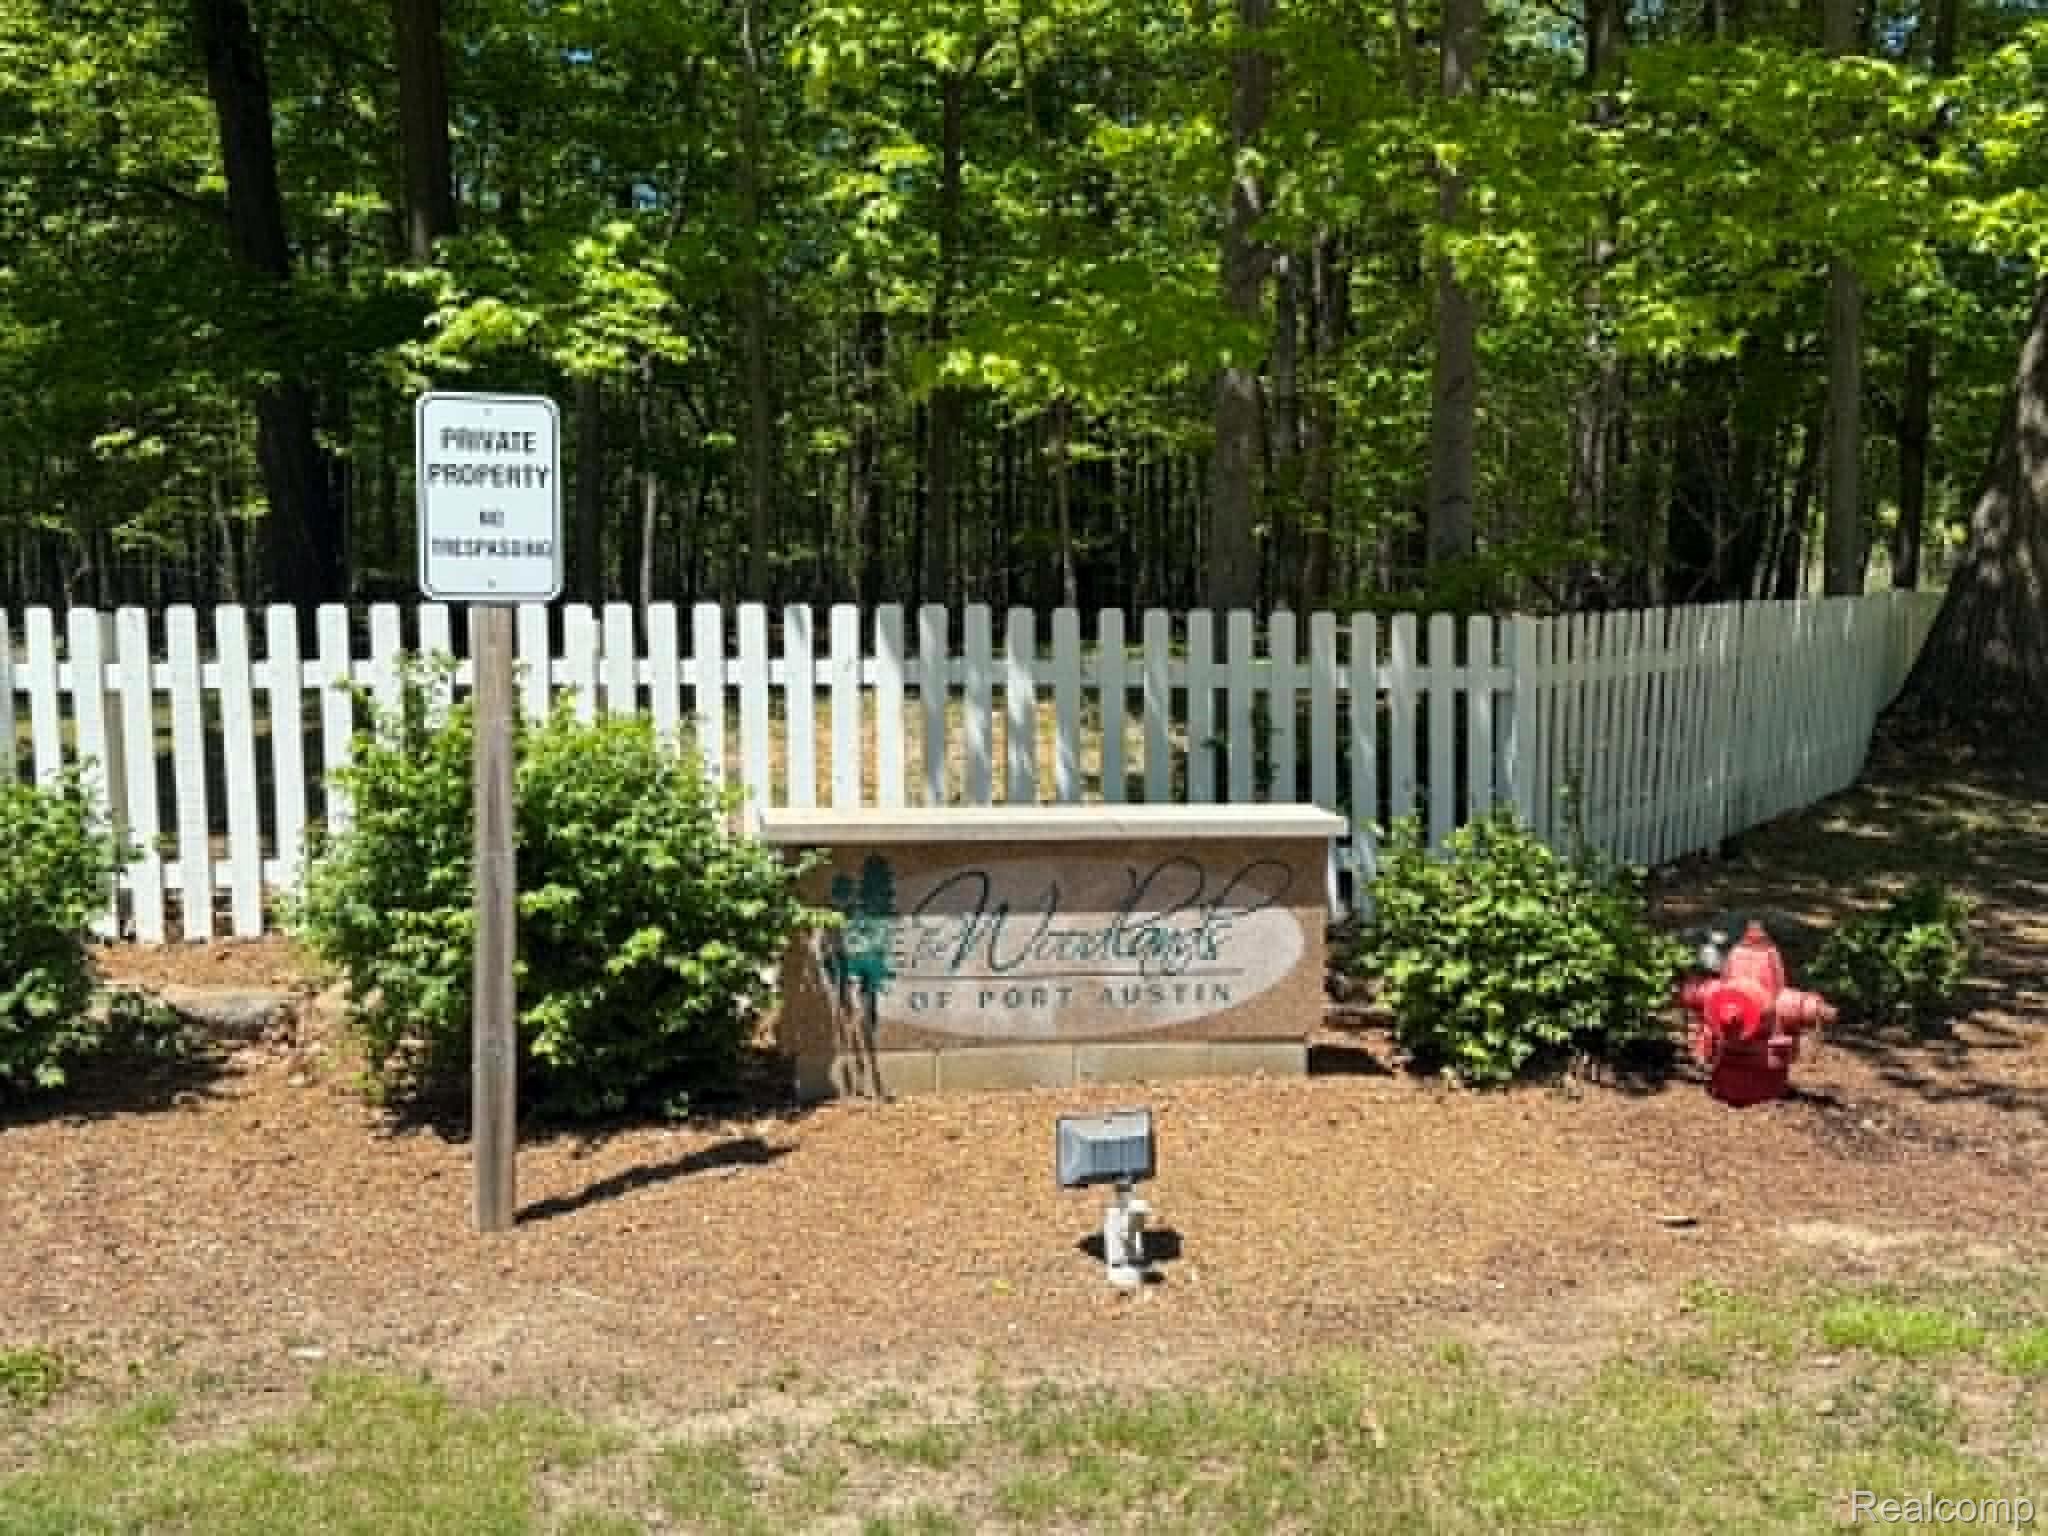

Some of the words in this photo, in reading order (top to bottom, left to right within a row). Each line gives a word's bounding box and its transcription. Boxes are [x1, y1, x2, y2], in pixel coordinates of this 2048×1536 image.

[439, 426, 537, 455] PRIVATE
[428, 464, 550, 489] PROPERTY
[910, 990, 952, 1012] OF
[978, 985, 1073, 1009] PORT
[1102, 982, 1232, 1006] AUSTIN
